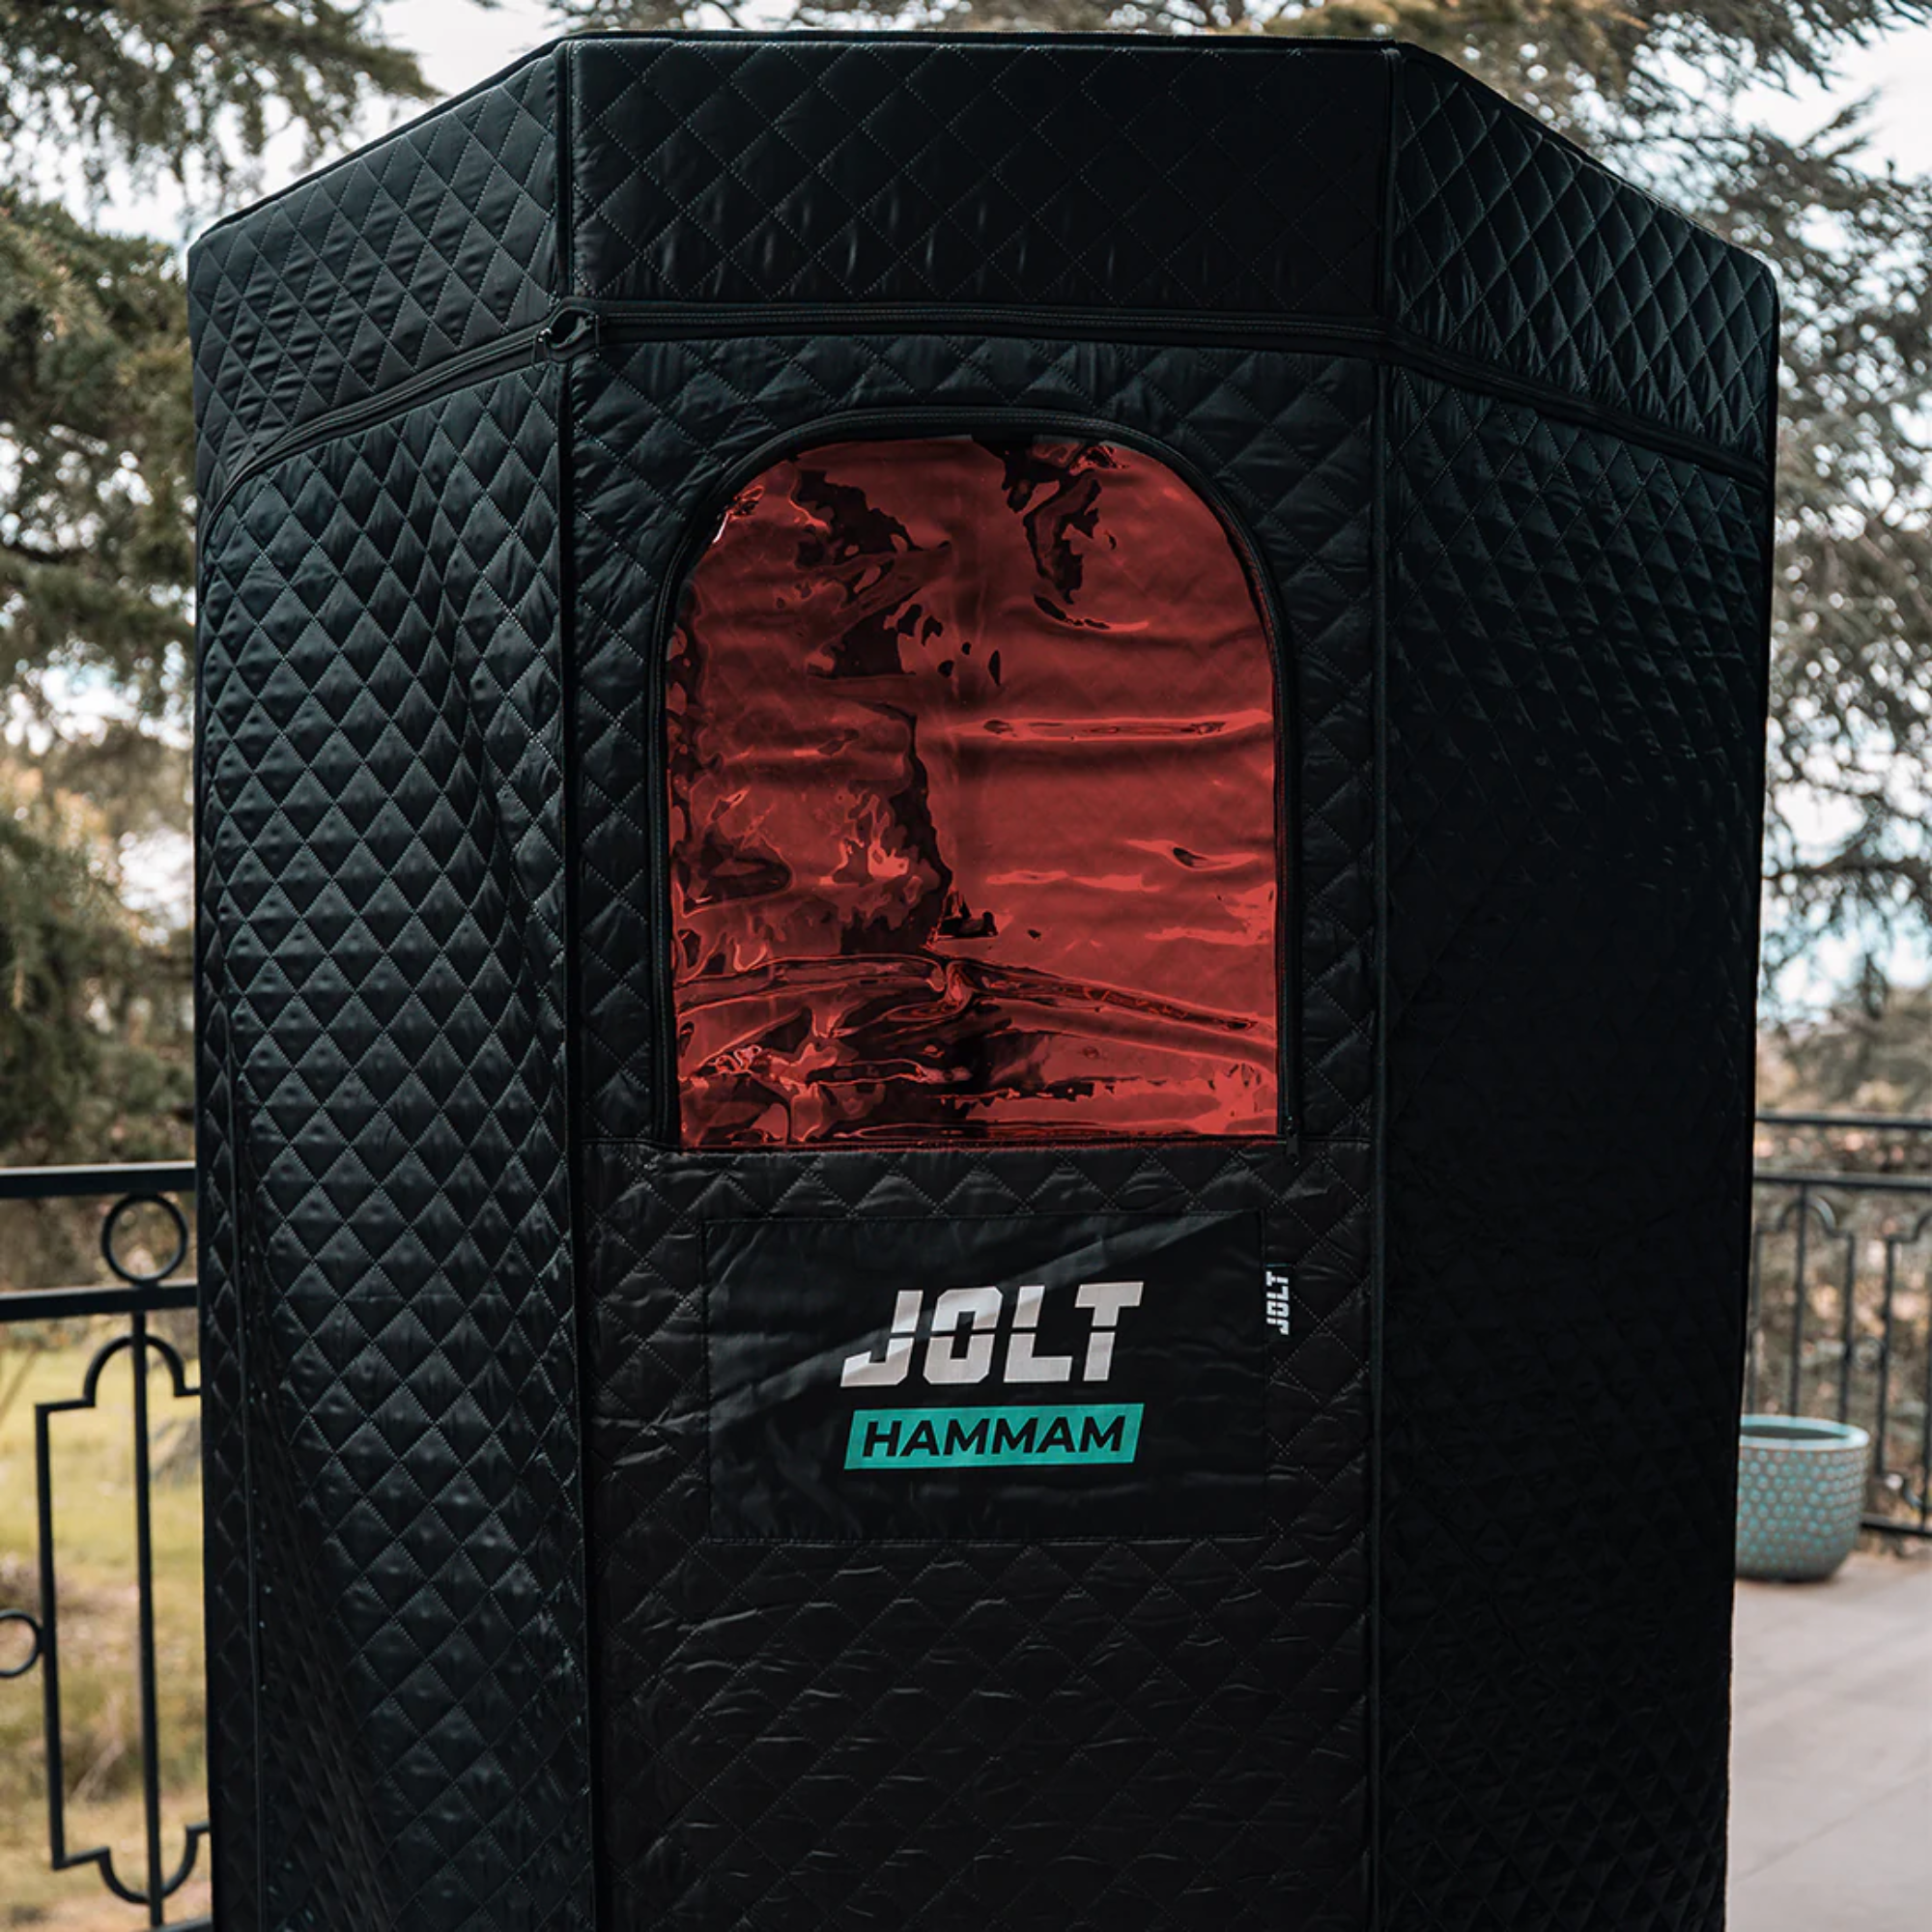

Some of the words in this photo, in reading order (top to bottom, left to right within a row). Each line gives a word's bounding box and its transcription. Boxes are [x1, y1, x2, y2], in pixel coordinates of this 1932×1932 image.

[840, 1282, 1144, 1387] JOLT
[1265, 1270, 1290, 1335] JOLT
[862, 1416, 1125, 1457] HAMMAM
